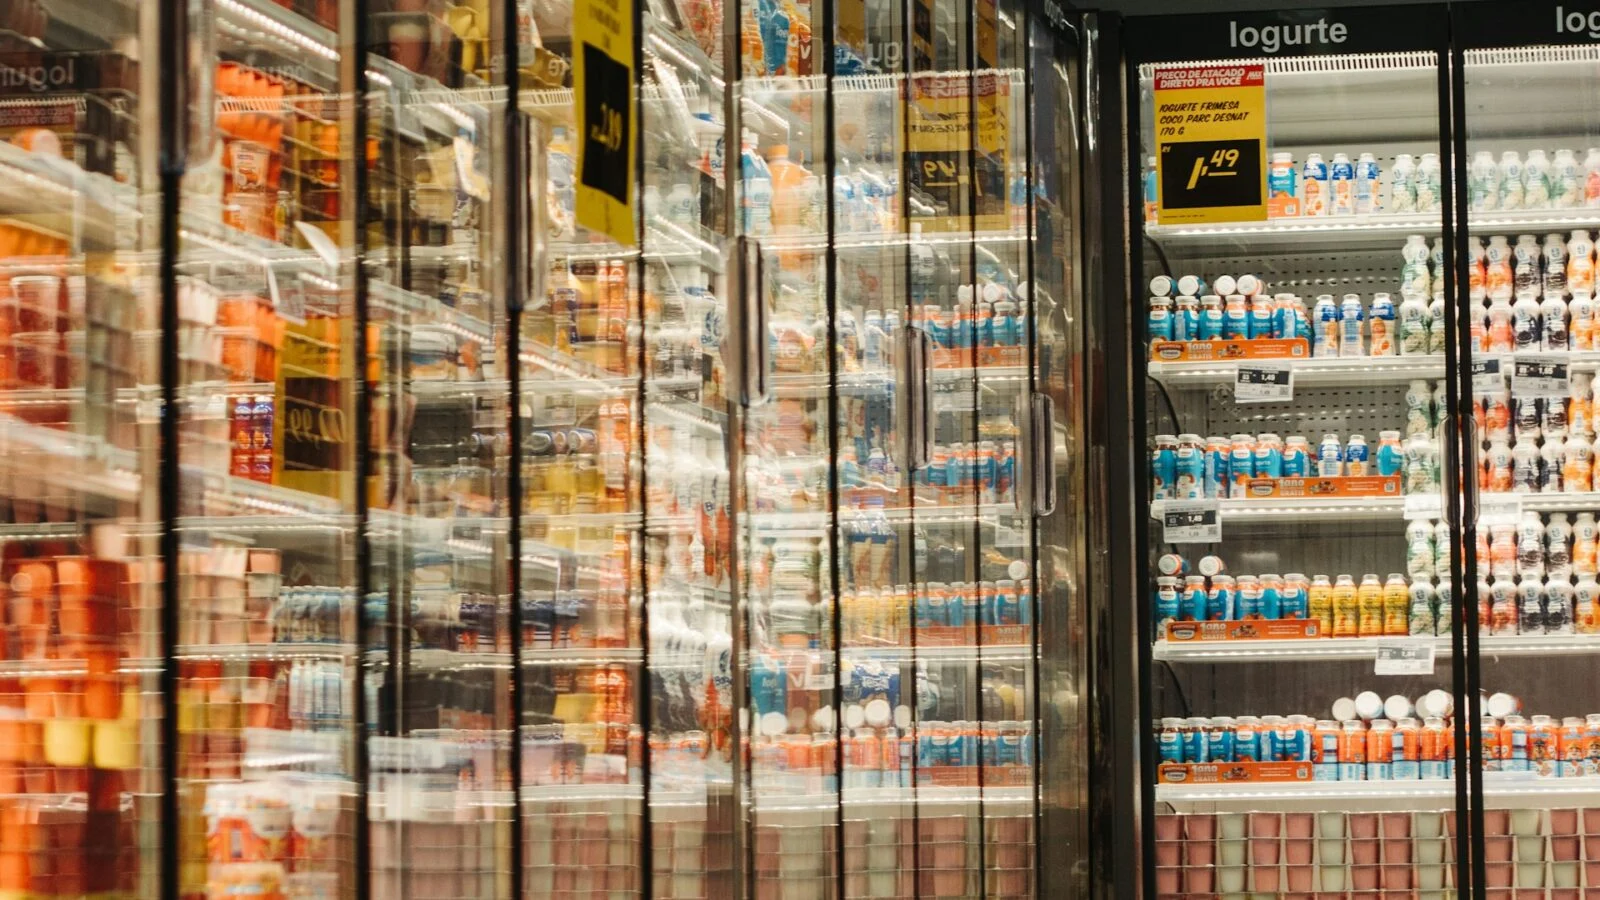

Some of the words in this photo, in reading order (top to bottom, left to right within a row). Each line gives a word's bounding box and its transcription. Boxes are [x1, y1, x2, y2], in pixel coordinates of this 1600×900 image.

[1229, 17, 1348, 53] Iogurte
[1188, 70, 1201, 79] DE
[1201, 68, 1245, 78] ATACADO
[1160, 79, 1195, 88] DIRETO
[1195, 78, 1215, 87] PRA
[1159, 102, 1198, 113] IOGURTE
[1200, 101, 1239, 111] FRIMESA
[1159, 115, 1183, 124] COCO
[1186, 113, 1210, 123] PARC
[1213, 112, 1249, 122] DESNAT
[1159, 127, 1176, 136] 170
[1178, 126, 1185, 136] G
